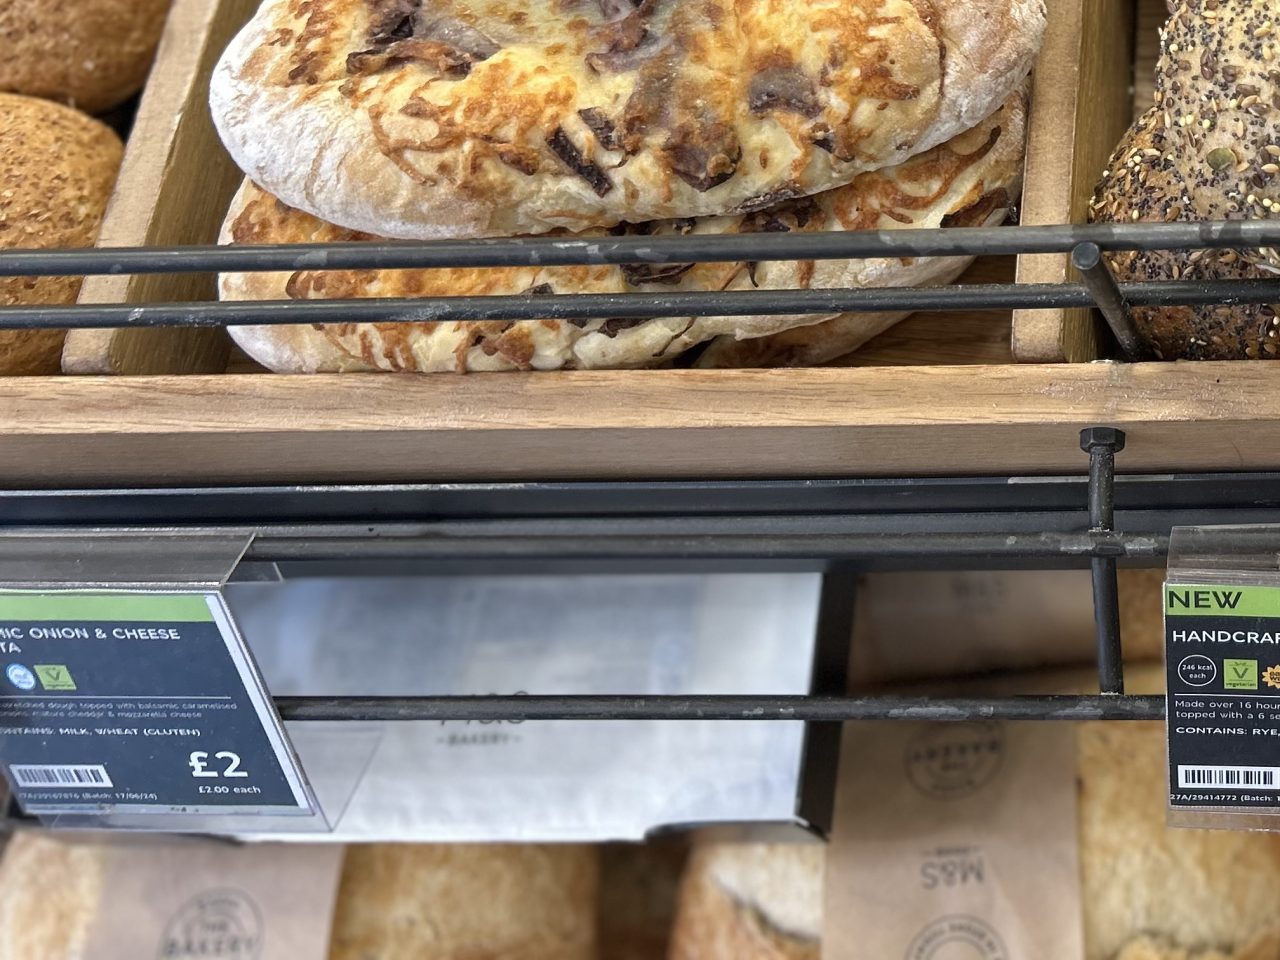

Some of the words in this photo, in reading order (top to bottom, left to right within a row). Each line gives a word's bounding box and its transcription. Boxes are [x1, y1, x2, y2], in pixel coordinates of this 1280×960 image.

[1168, 590, 1242, 610] NEW
[29, 627, 89, 640] ONION
[95, 628, 107, 640] &
[112, 628, 181, 640] CHEESE
[1175, 700, 1205, 708] Made
[1239, 701, 1252, 709] 16
[1176, 711, 1216, 719] topped
[1220, 711, 1243, 719] with
[1175, 727, 1248, 735] CONTAINS:
[1252, 728, 1280, 737] RYE,
[189, 751, 248, 778] £2
[199, 786, 229, 794] £2.00
[233, 786, 261, 794] each
[1240, 794, 1273, 803] (Batch:
